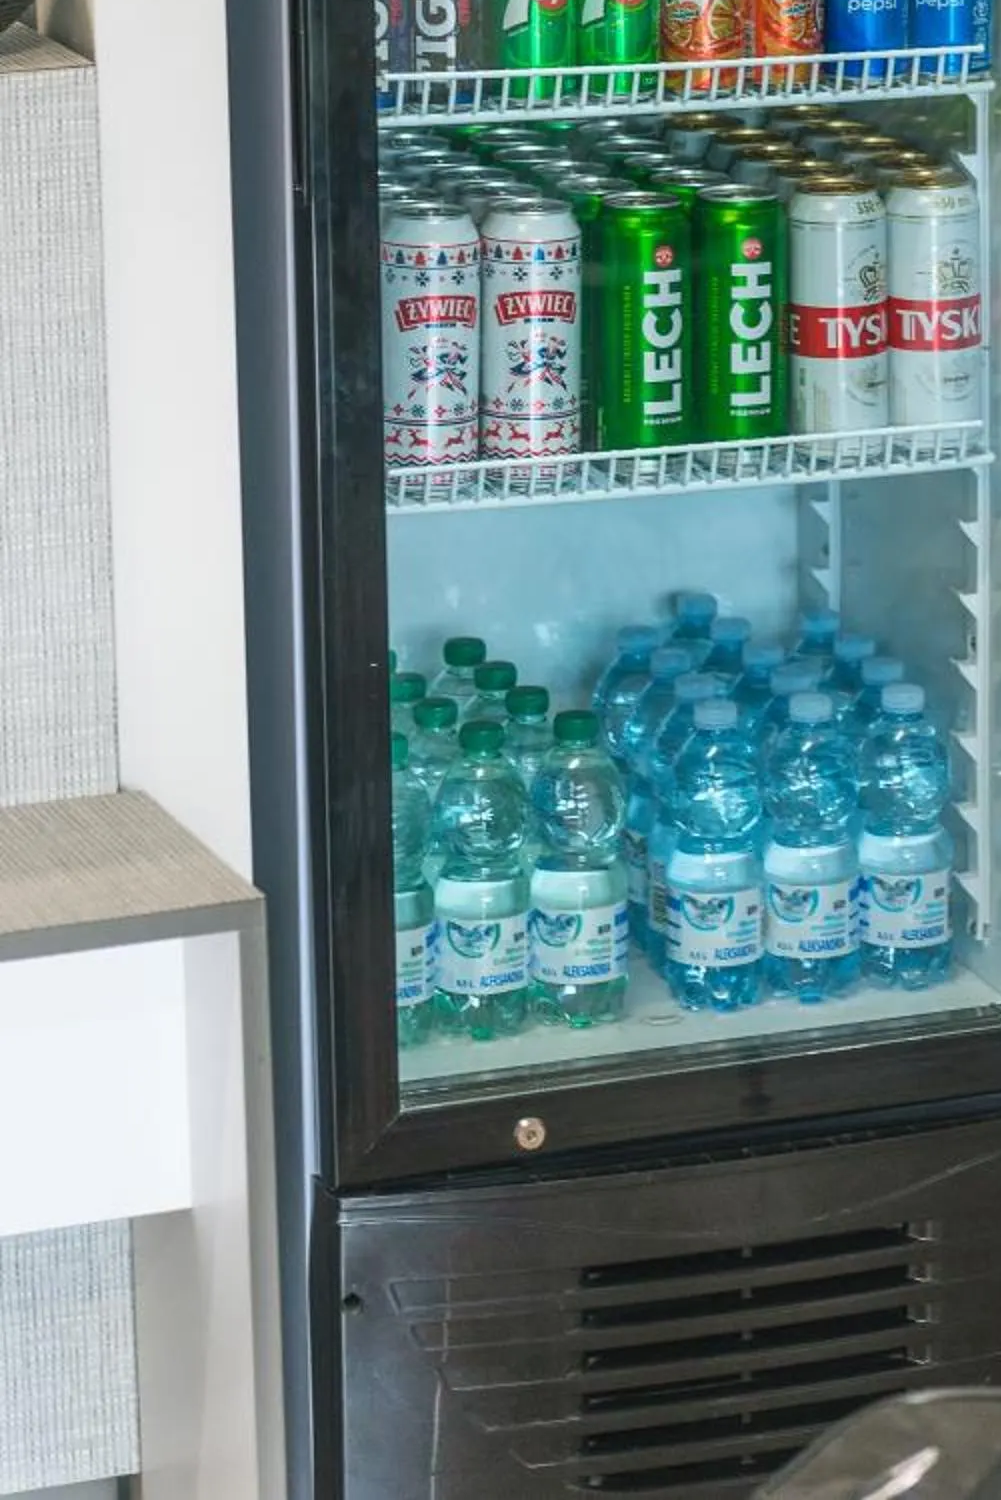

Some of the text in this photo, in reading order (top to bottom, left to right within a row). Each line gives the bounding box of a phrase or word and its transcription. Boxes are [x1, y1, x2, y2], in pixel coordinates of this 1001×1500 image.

[504, 294, 572, 316] ŻYWIEC
[642, 268, 683, 415] LECH
[729, 261, 773, 407] LECH
